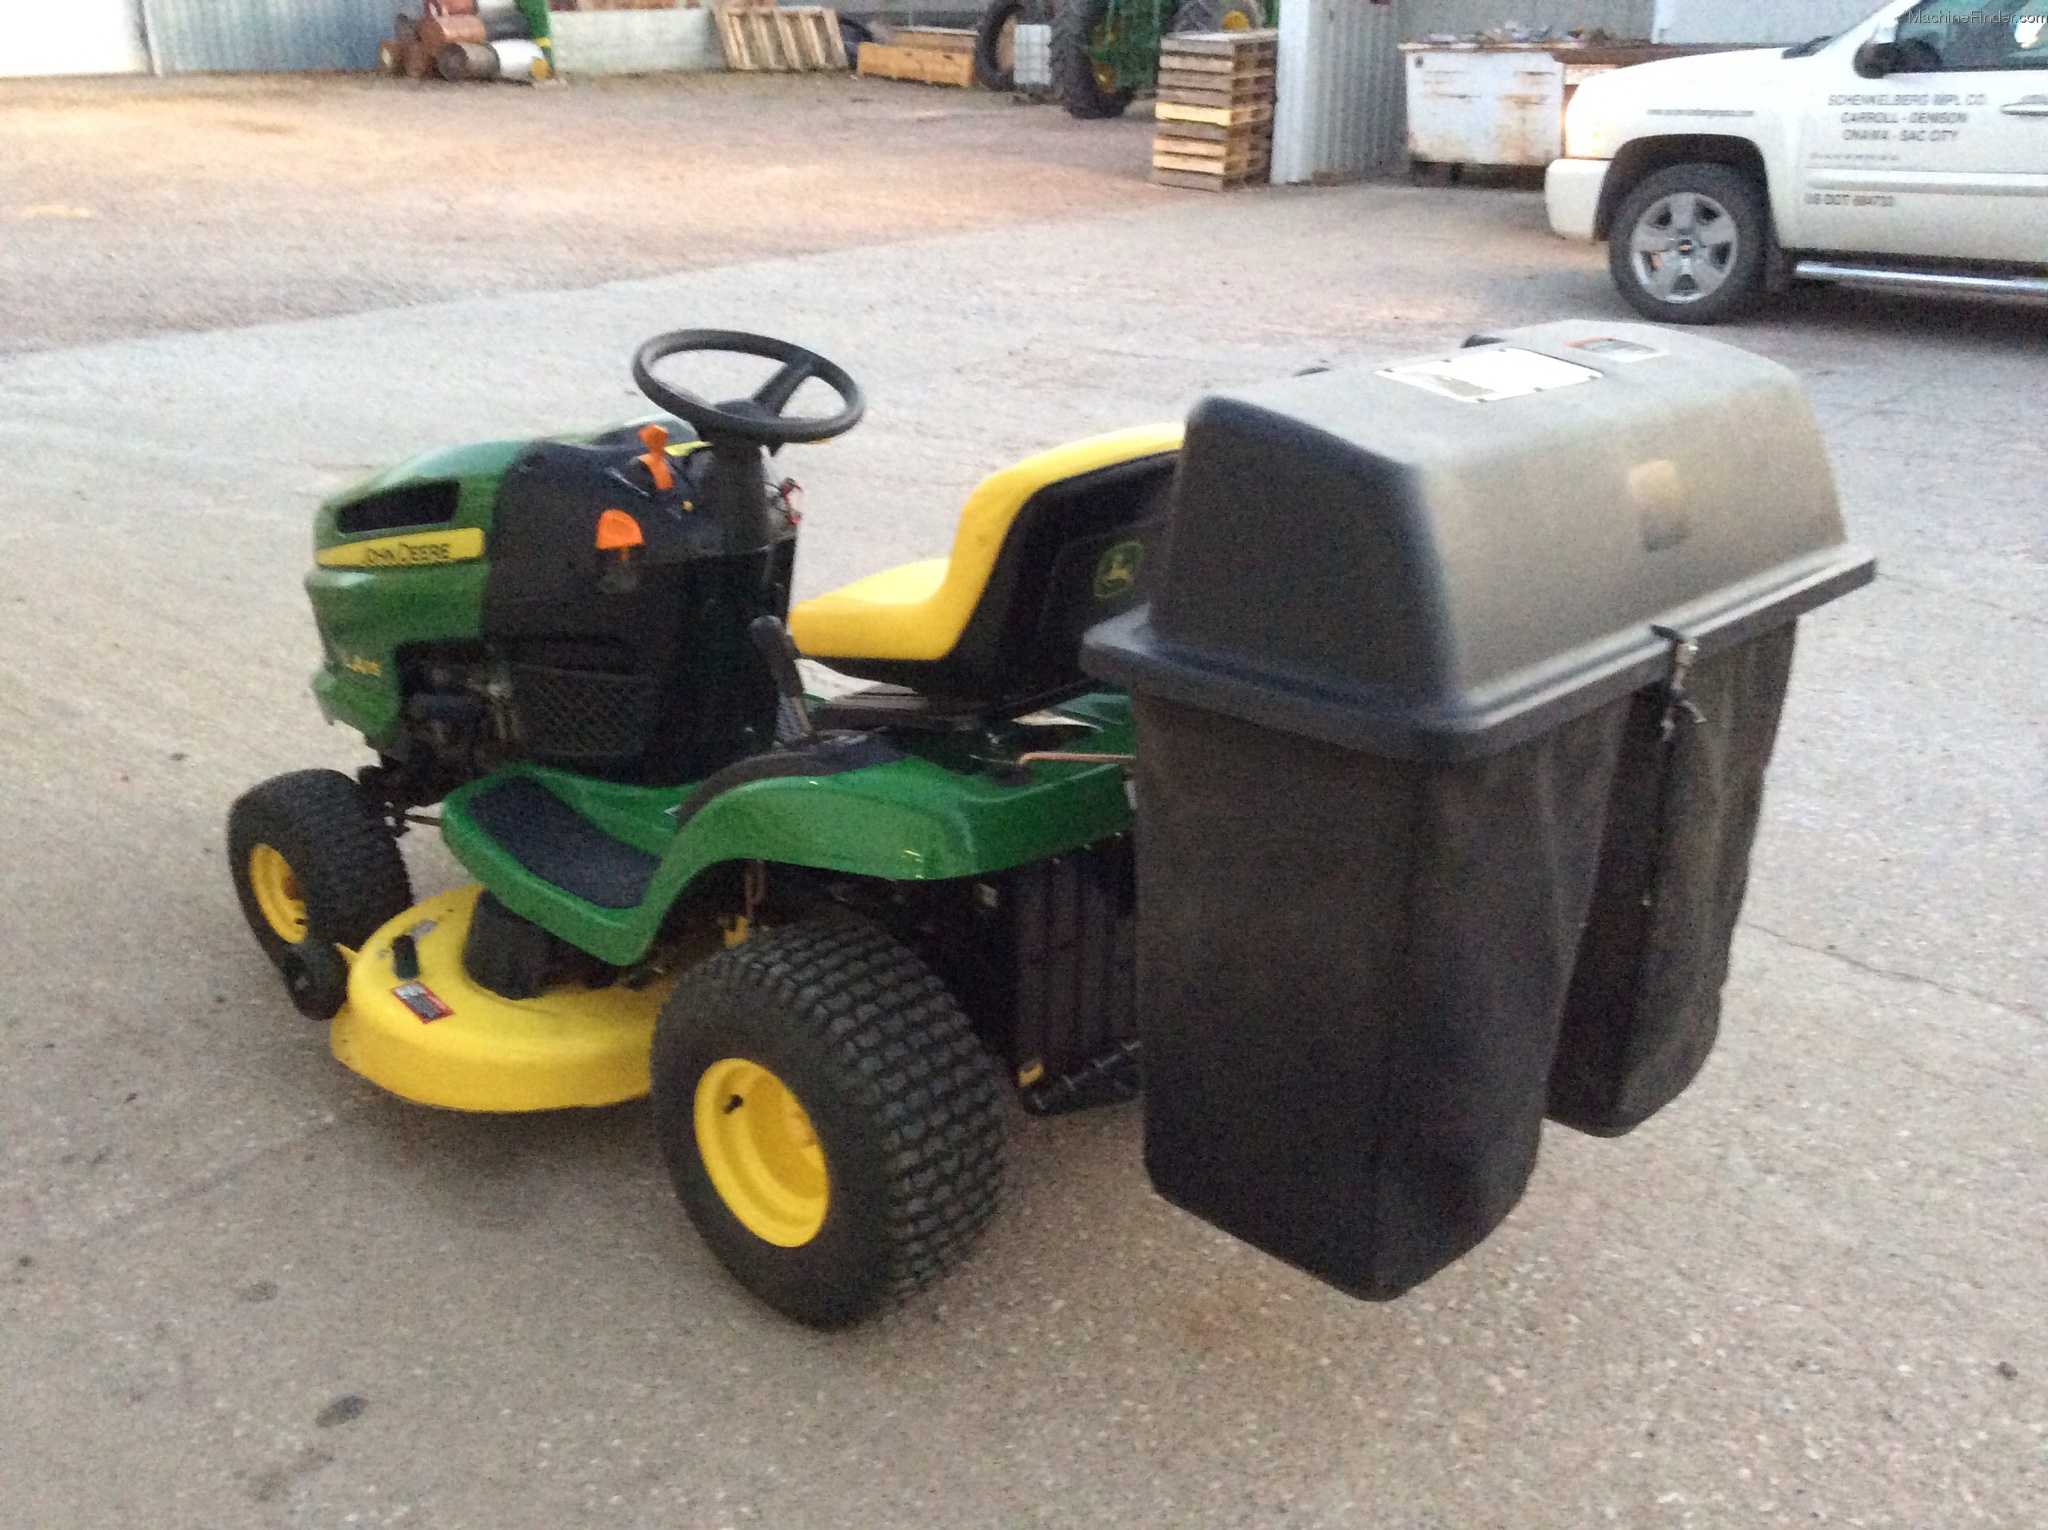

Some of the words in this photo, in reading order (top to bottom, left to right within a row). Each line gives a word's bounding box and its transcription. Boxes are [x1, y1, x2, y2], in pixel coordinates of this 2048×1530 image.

[1840, 112, 1898, 123] CARROLL
[1909, 112, 1967, 123] DENISON
[1900, 130, 1926, 141] SAC
[1929, 130, 1959, 141] CITY
